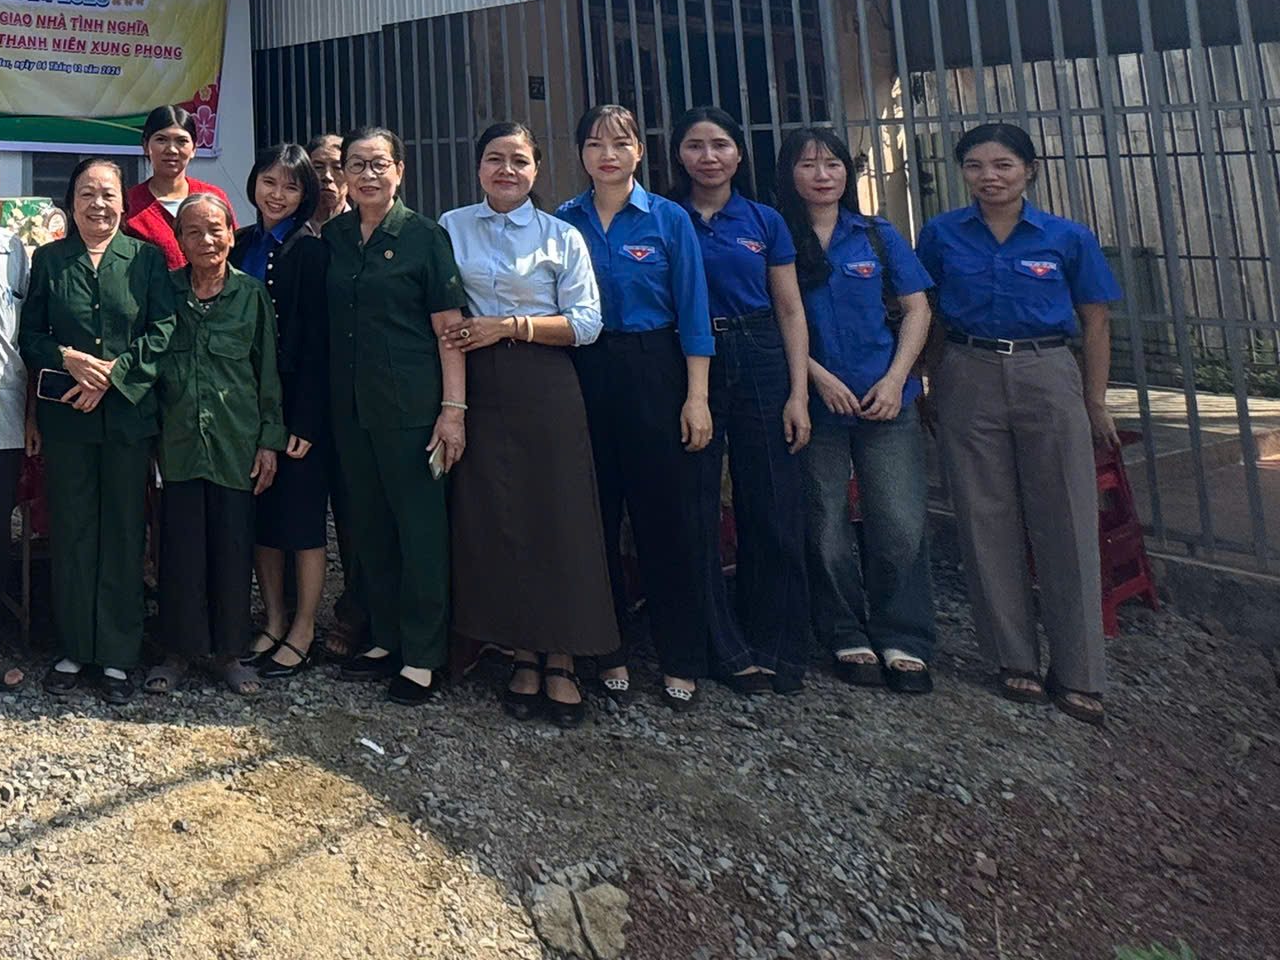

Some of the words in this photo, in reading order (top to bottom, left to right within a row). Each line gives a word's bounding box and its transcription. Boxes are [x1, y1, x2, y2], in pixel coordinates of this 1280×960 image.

[0, 11, 32, 27] GIAO
[36, 12, 67, 30] NHÀ
[70, 14, 103, 32] TÌNH
[107, 19, 149, 36] NGHĨA
[52, 36, 87, 54] NIÊN
[89, 40, 131, 56] XUNG
[134, 44, 183, 60] PHONG
